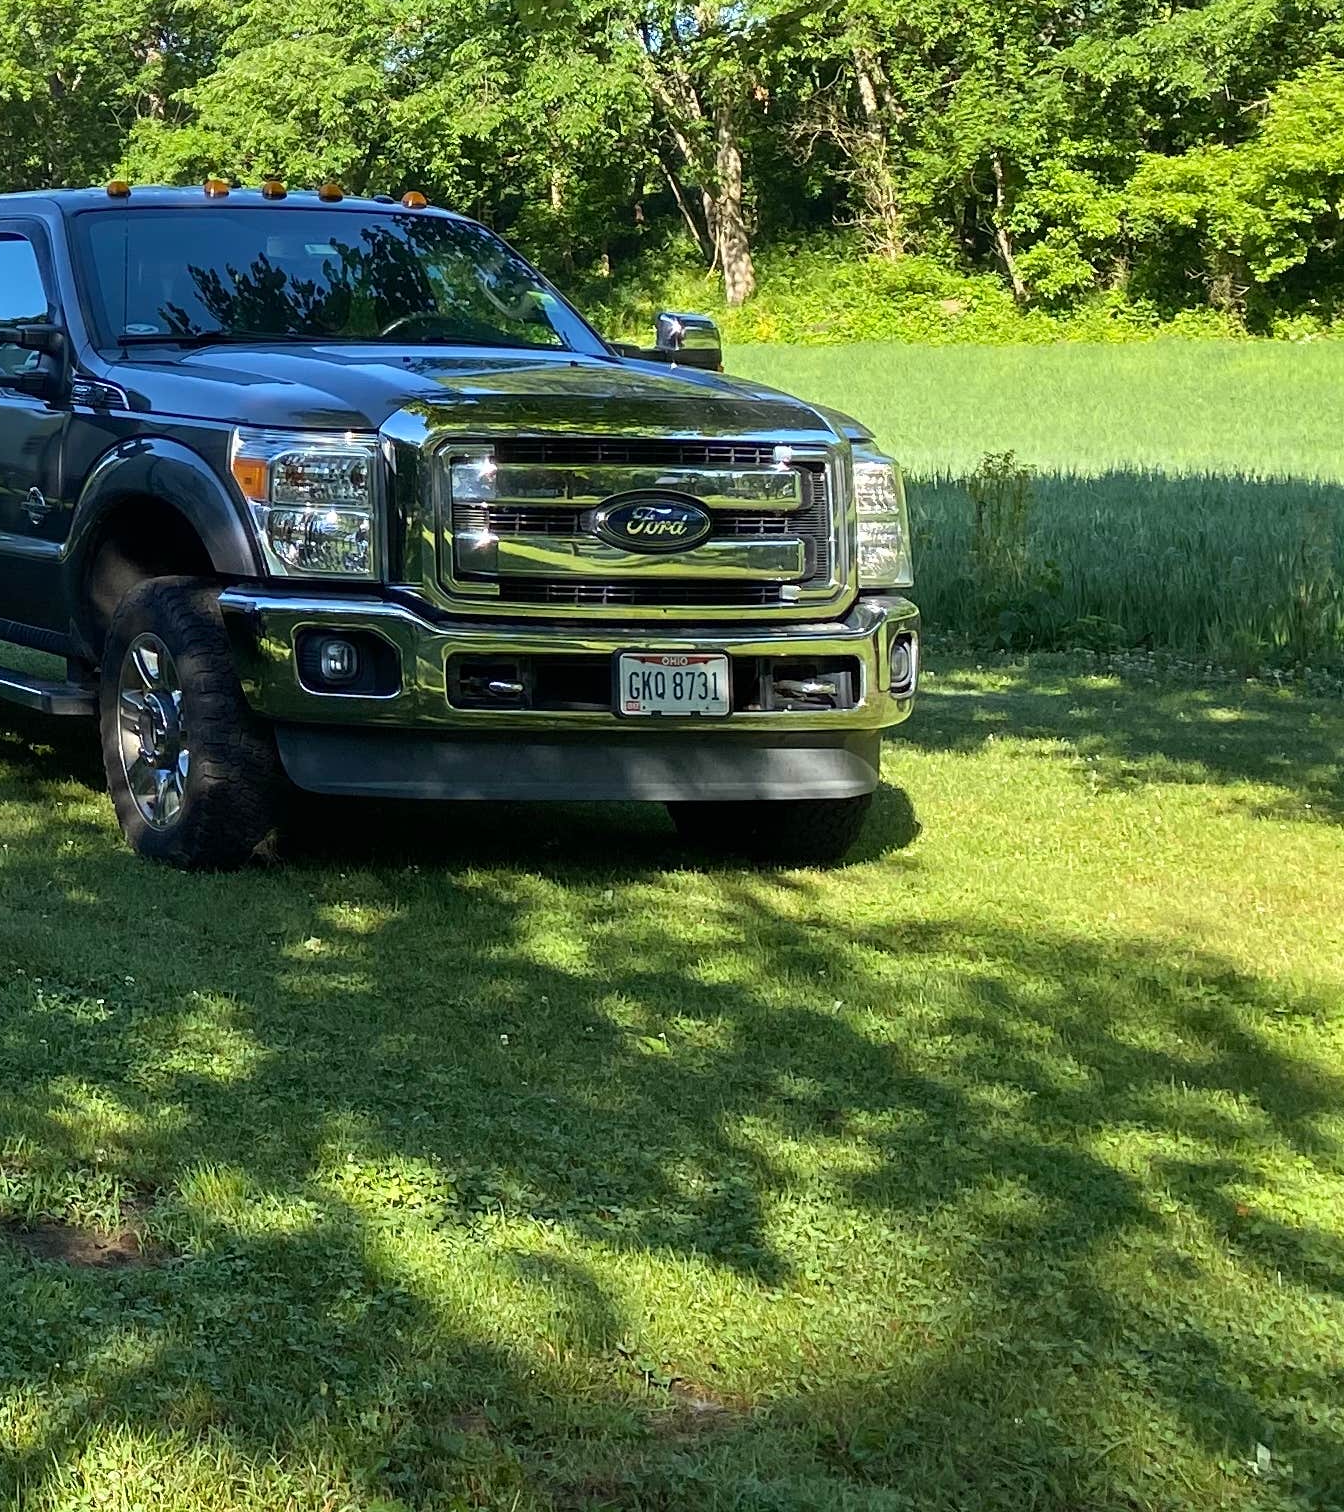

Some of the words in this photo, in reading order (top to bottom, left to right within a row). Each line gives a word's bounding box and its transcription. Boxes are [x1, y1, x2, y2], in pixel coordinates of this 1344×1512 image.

[627, 506, 688, 535] Ford
[661, 656, 689, 666] OHIO
[629, 671, 665, 700] GKQ
[673, 671, 720, 701] 8731
